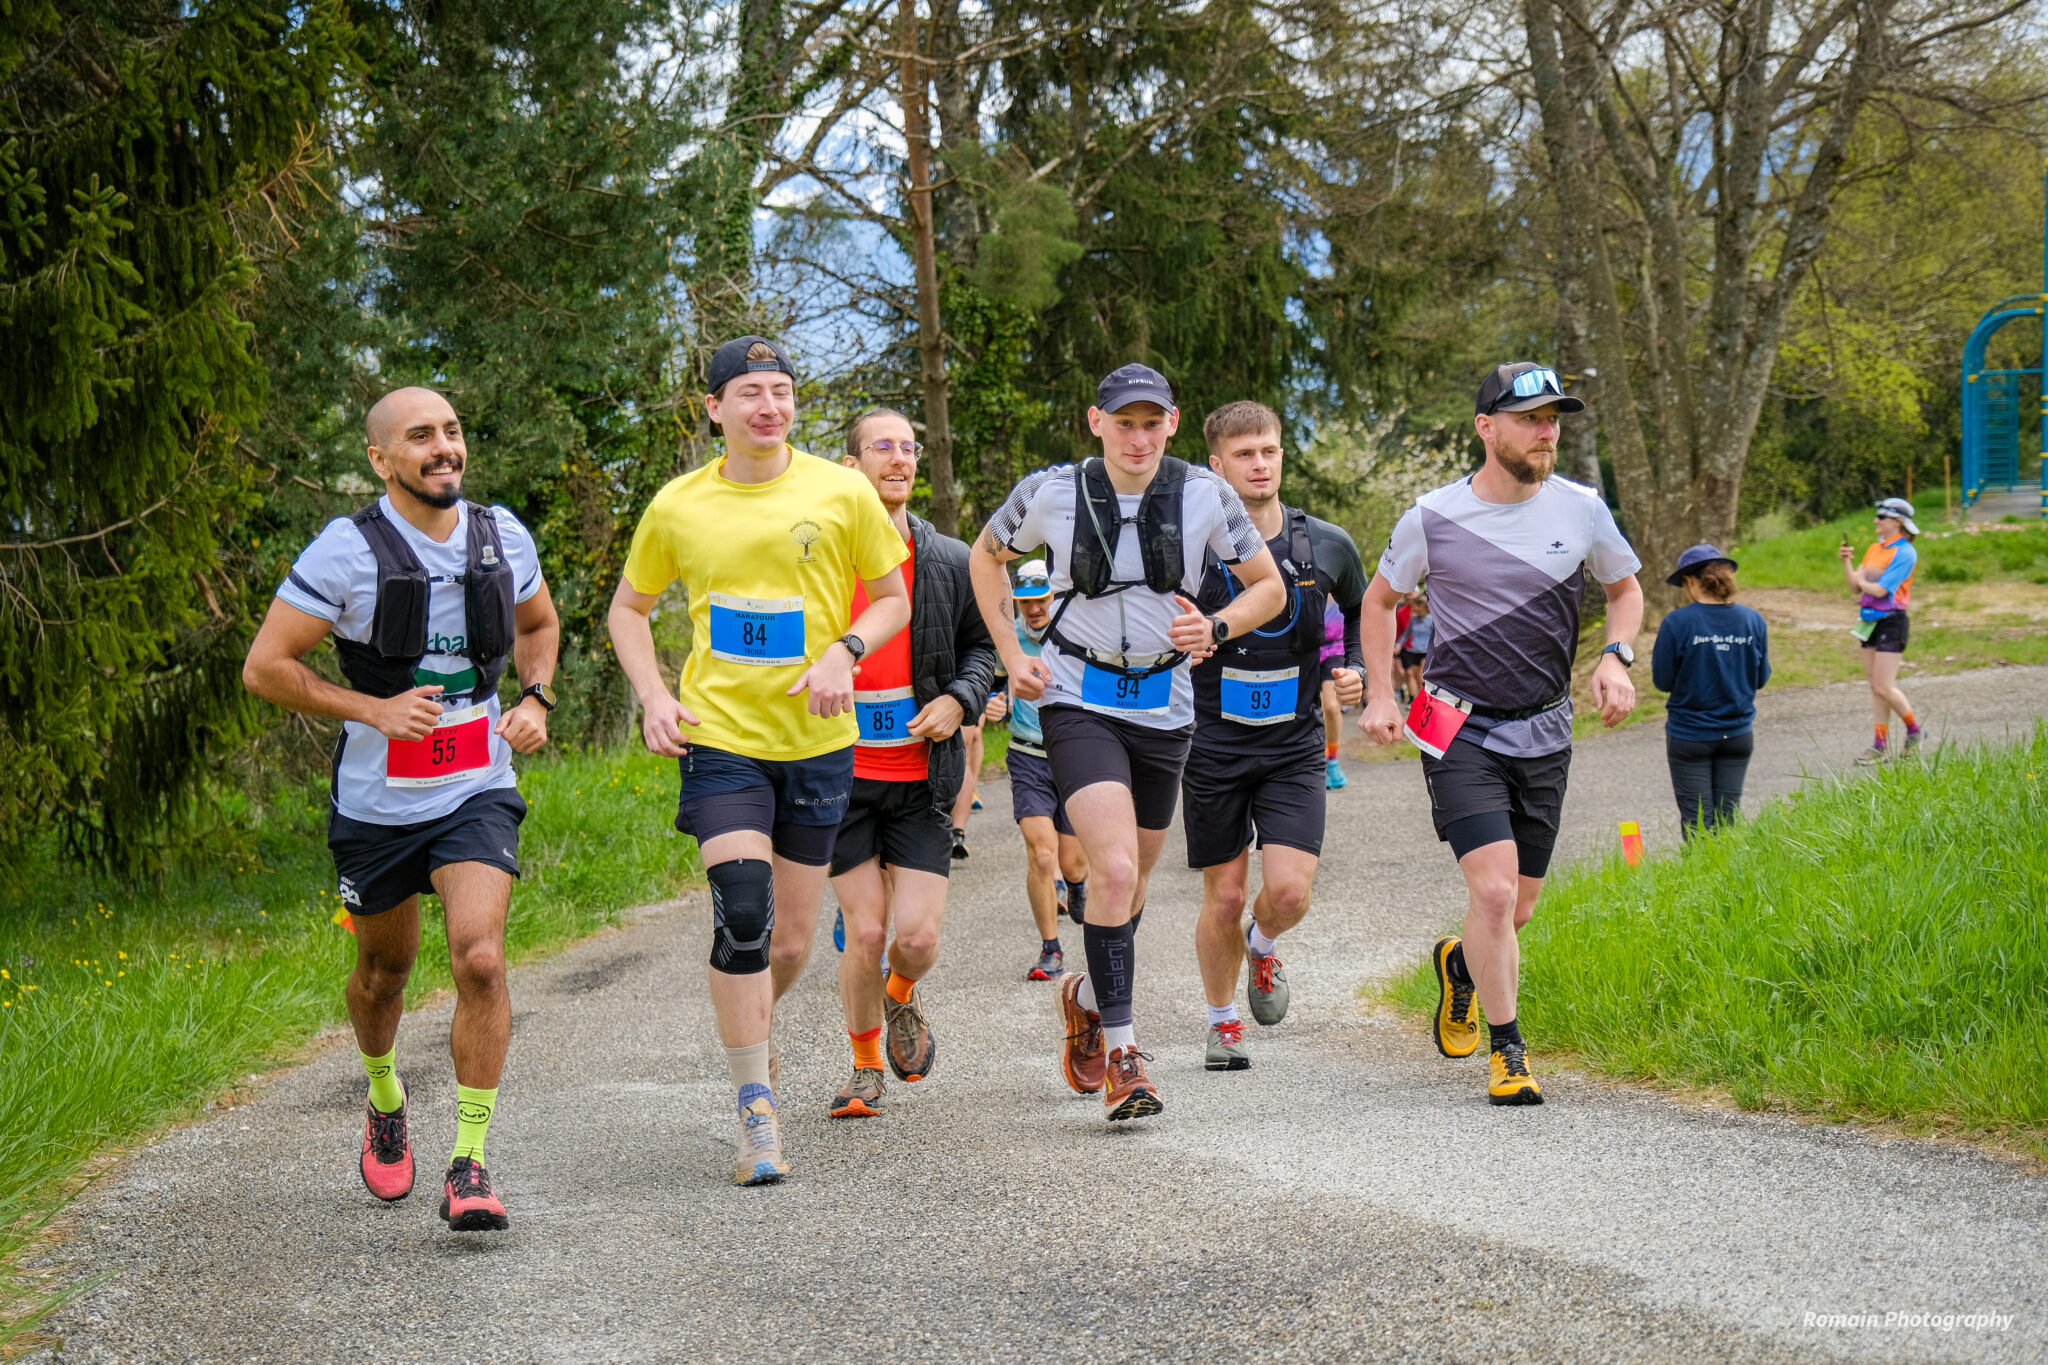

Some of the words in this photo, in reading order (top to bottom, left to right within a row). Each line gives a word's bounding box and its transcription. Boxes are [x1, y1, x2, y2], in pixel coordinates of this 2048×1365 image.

[735, 612, 776, 621] MARATOUR
[743, 621, 767, 647] 84
[744, 648, 767, 656] THOMAS
[1116, 677, 1140, 699] 94
[1250, 690, 1271, 709] 93
[873, 710, 895, 731] 85
[431, 737, 457, 765] 55
[1101, 939, 1127, 999] kalenji
